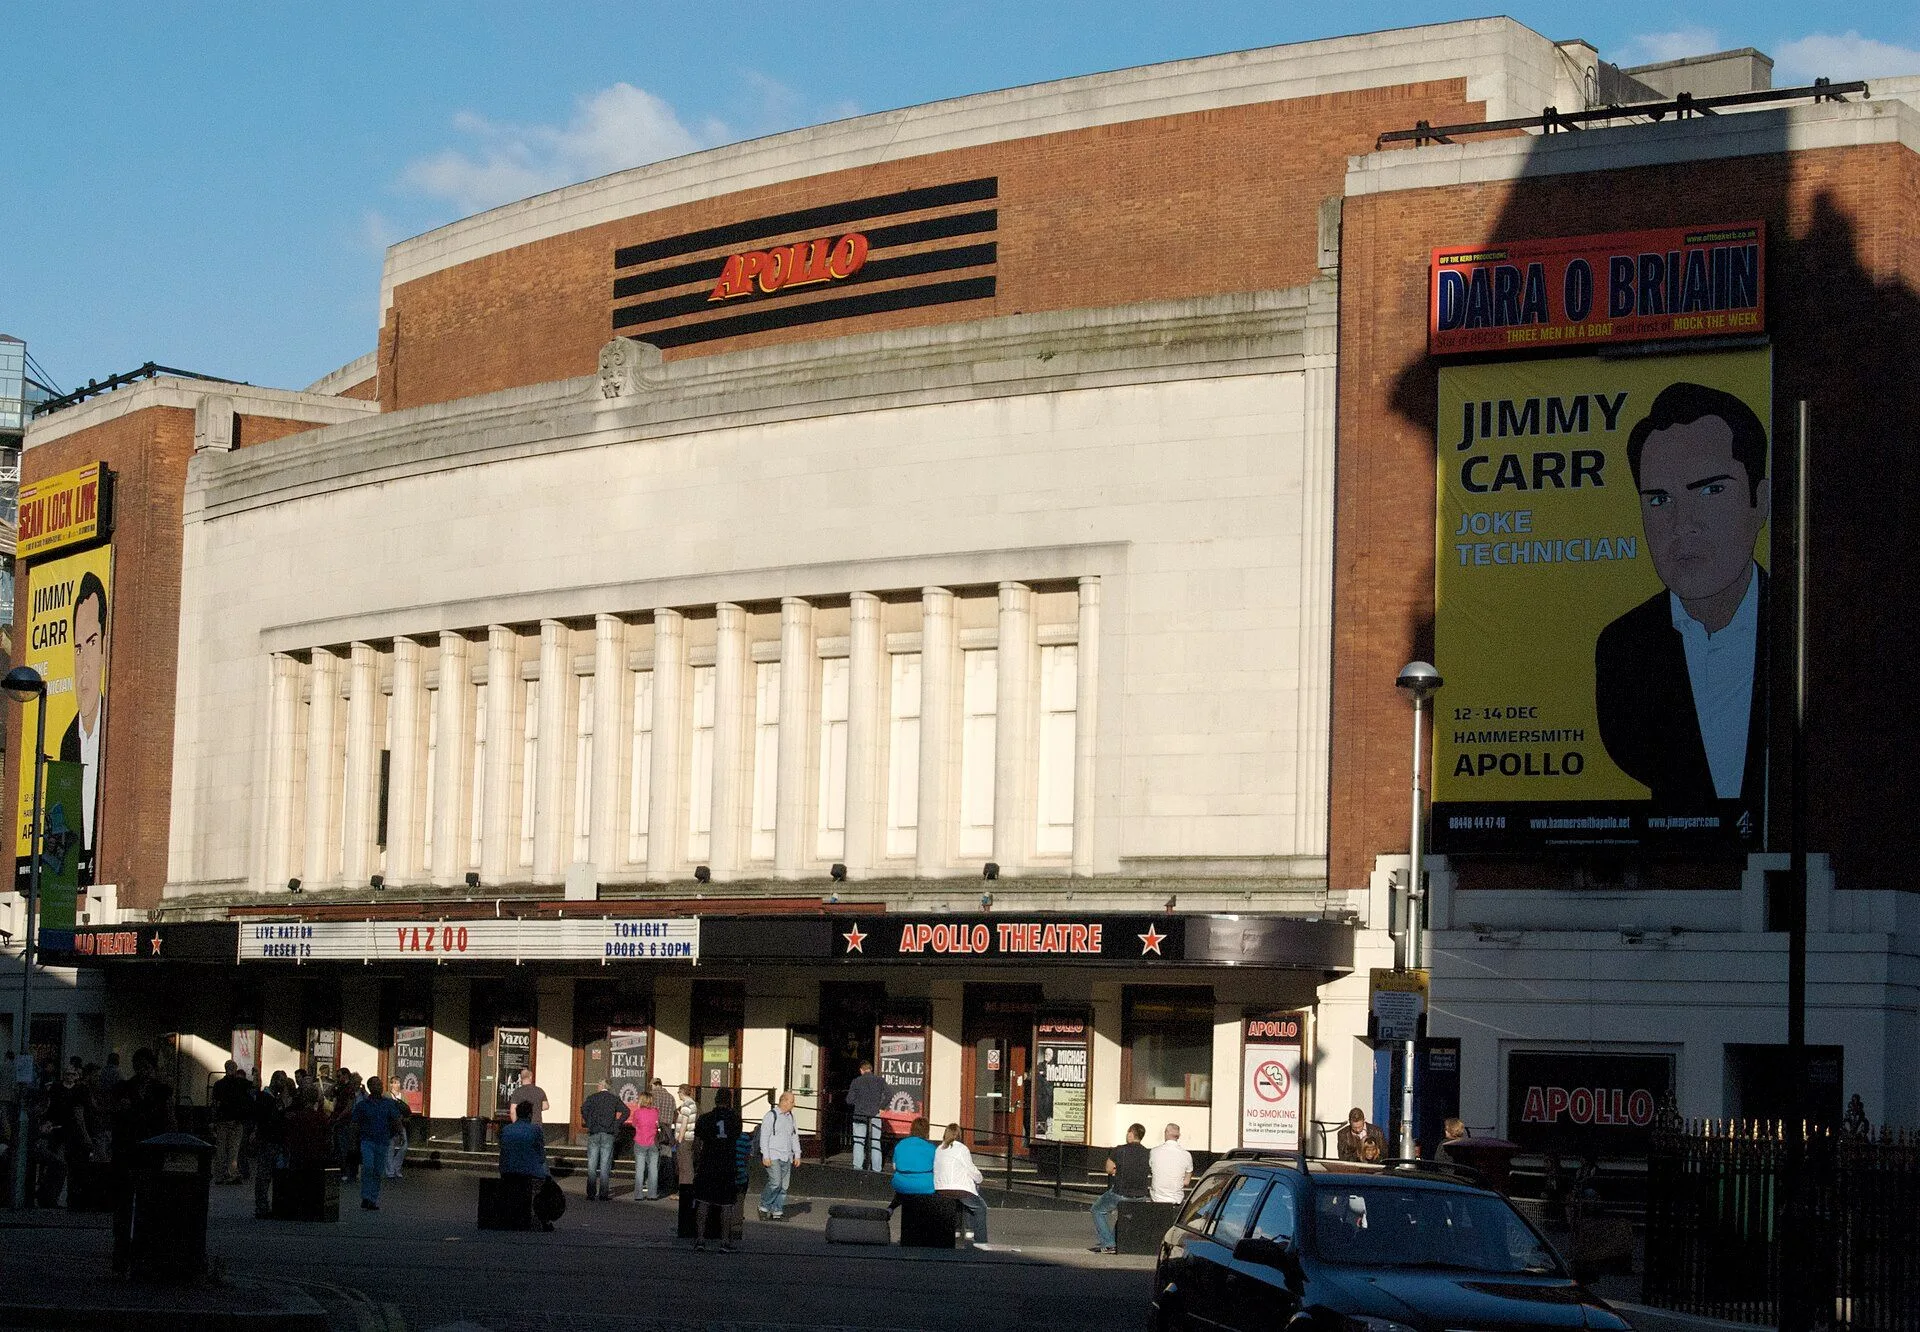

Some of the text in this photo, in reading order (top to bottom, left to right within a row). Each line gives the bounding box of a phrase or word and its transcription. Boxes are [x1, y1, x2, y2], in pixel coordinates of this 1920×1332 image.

[707, 233, 869, 301] APOLLO
[1460, 254, 1472, 262] KERB
[1437, 243, 1759, 332] DARA O BRIAIN
[1506, 328, 1538, 343] THREE
[1540, 327, 1562, 340] MEN
[1564, 325, 1577, 338] IN
[1578, 324, 1585, 337] A
[1588, 323, 1614, 336] BOAT
[1673, 316, 1704, 331] MOCK
[1707, 314, 1725, 328] THE
[1728, 312, 1759, 327] WEEK
[1456, 392, 1629, 451] JIMMY
[1460, 449, 1606, 493] CARR
[18, 498, 45, 541] SEAN
[46, 488, 74, 534] LOCK
[1455, 510, 1533, 535] JOKE
[1455, 536, 1637, 567] TECHNICIAN
[32, 580, 75, 622] JIMMY
[32, 619, 68, 650] CARR
[1506, 706, 1538, 719] DEC
[1454, 729, 1585, 744] HAMMERSMITH
[1453, 751, 1585, 777] APOLLO
[1474, 816, 1484, 829] 44
[1485, 816, 1494, 829] 47
[255, 926, 313, 940] LIVE NATION
[614, 922, 669, 938] TONIGHT
[899, 923, 1103, 953] APOLLO THEATRE
[96, 931, 138, 955] THEATRE
[605, 942, 645, 957] DOORS
[1248, 1021, 1298, 1037] APOLLO
[611, 1052, 646, 1067] LEAGUE
[881, 1058, 924, 1075] LEAGUE
[1247, 1109, 1258, 1118] NO
[1522, 1086, 1654, 1126] APOLLO
[716, 1120, 728, 1138] 1
